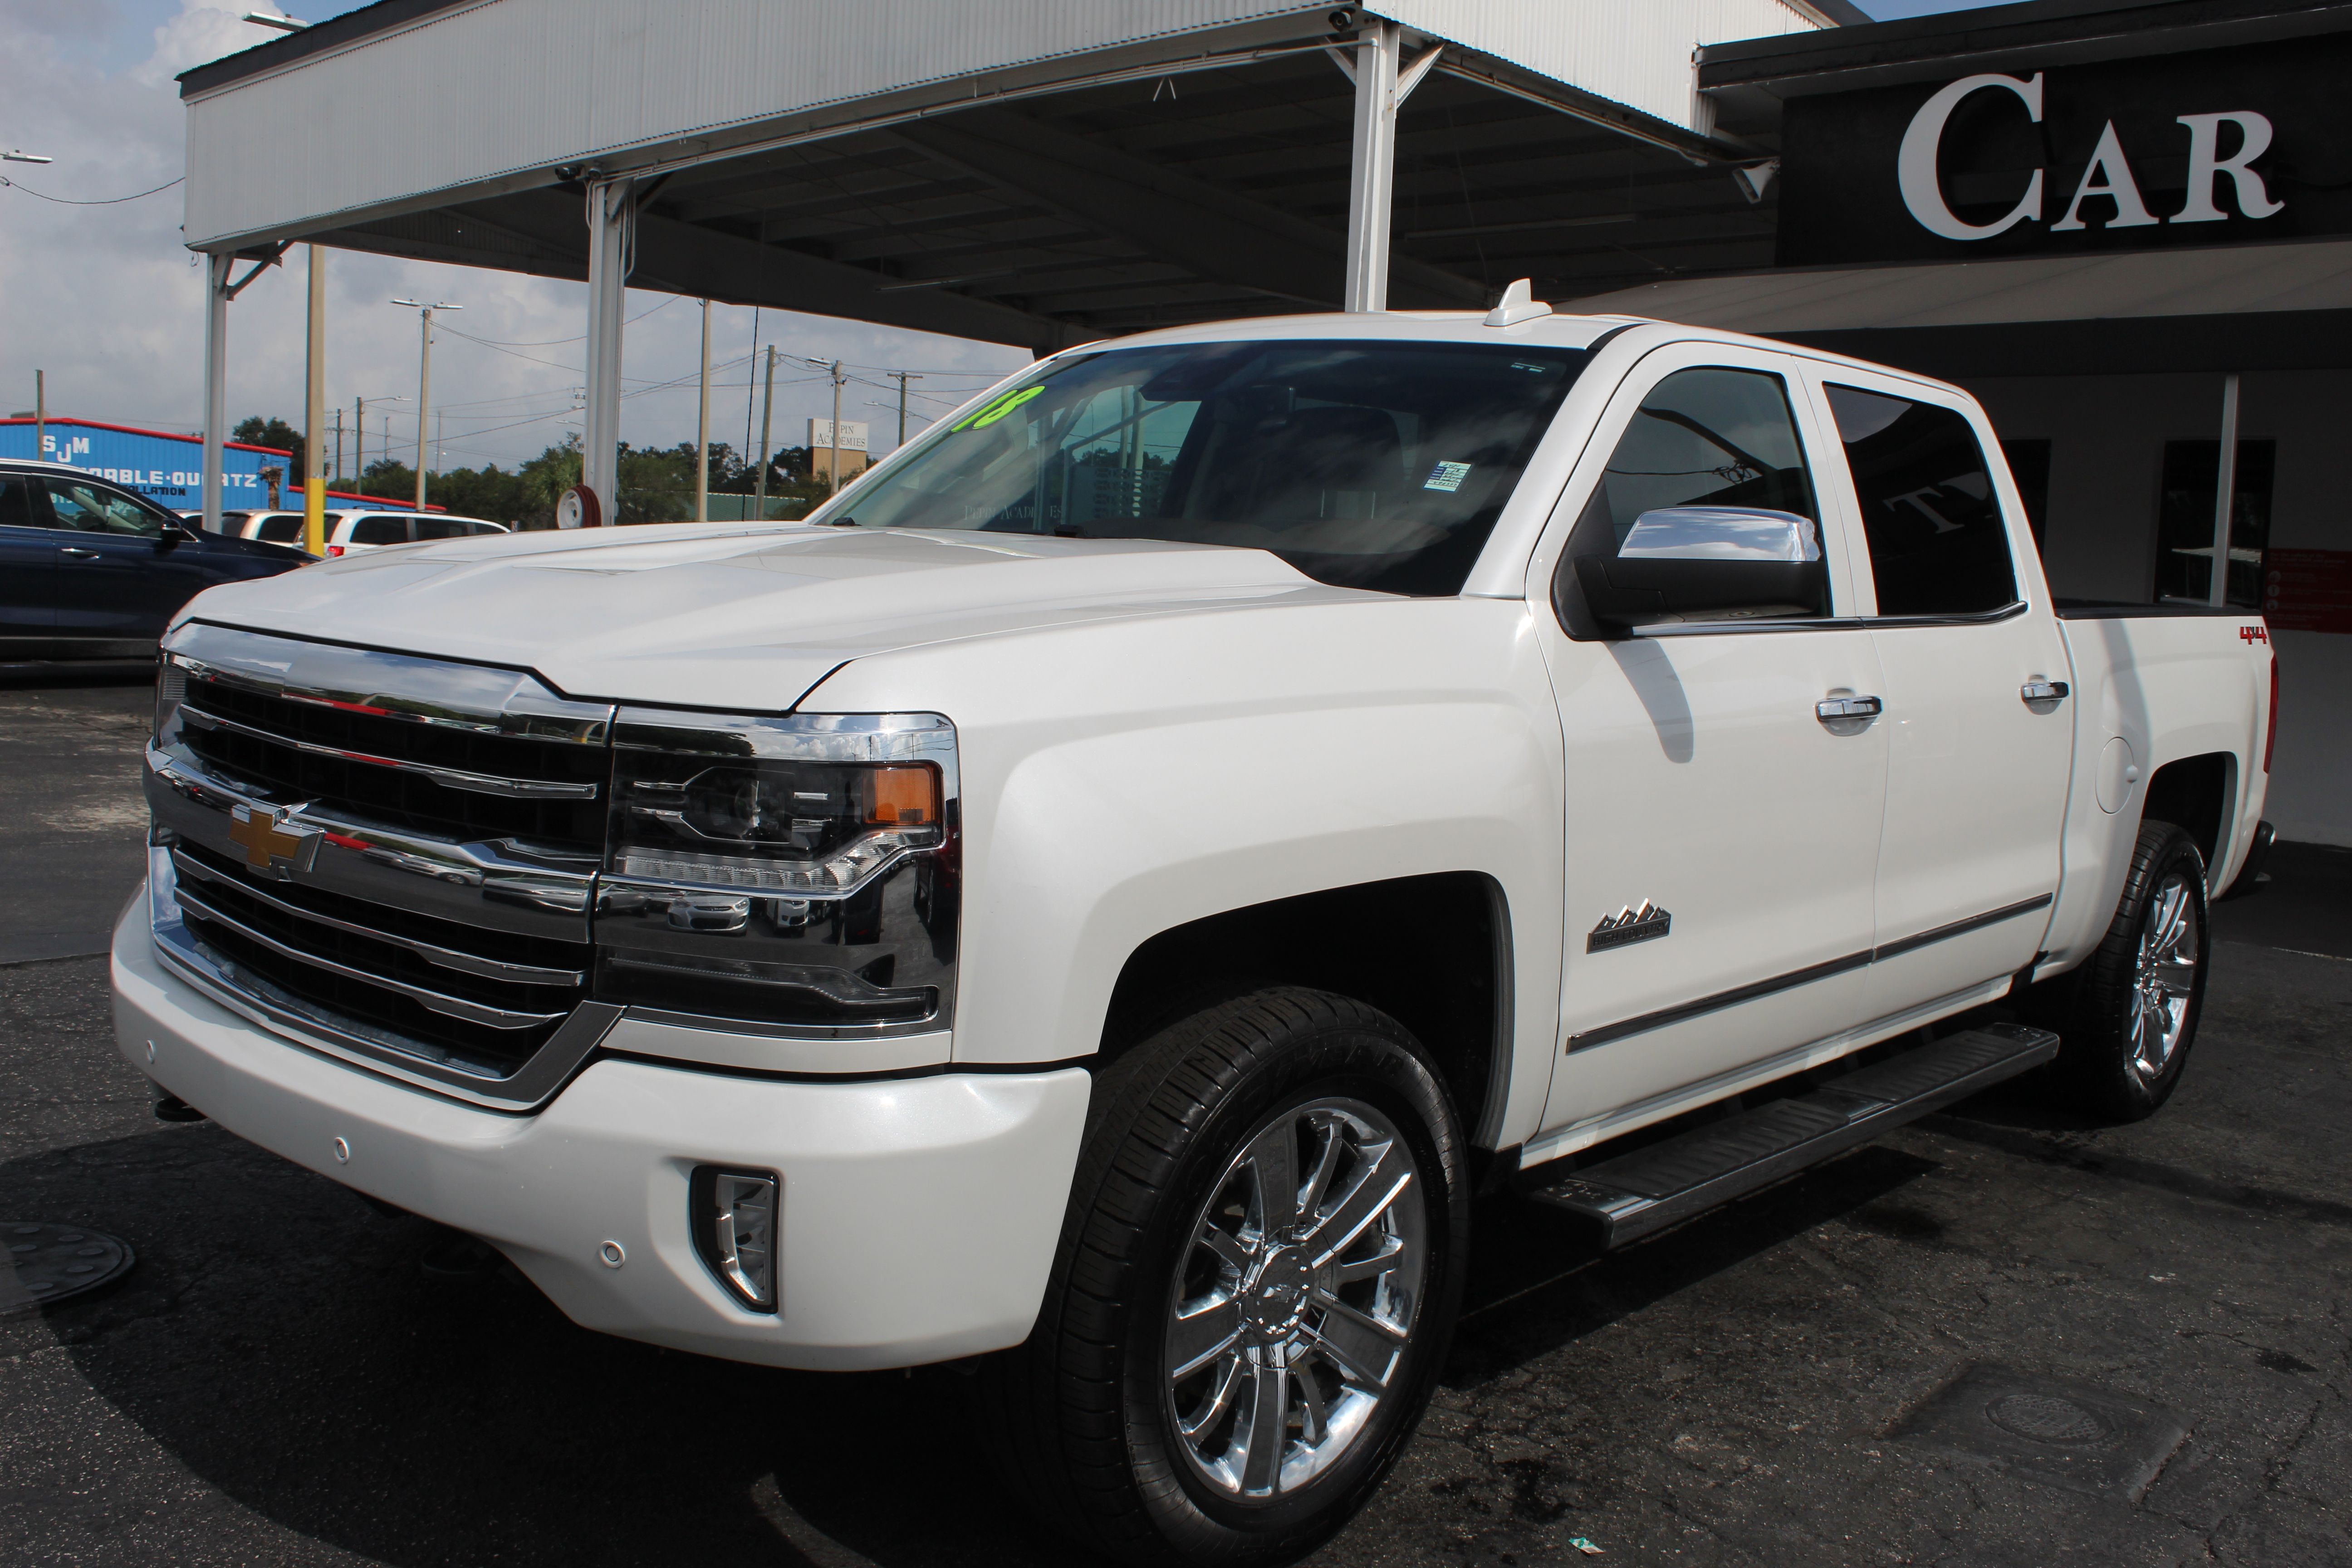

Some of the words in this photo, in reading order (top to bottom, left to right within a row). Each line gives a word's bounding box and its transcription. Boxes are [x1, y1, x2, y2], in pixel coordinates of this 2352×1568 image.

[951, 386, 1045, 433] 18
[828, 421, 854, 434] PPIN
[43, 435, 89, 463] SJM
[1593, 931, 1619, 947] HIGH
[1622, 920, 1669, 940] COUNTRY
